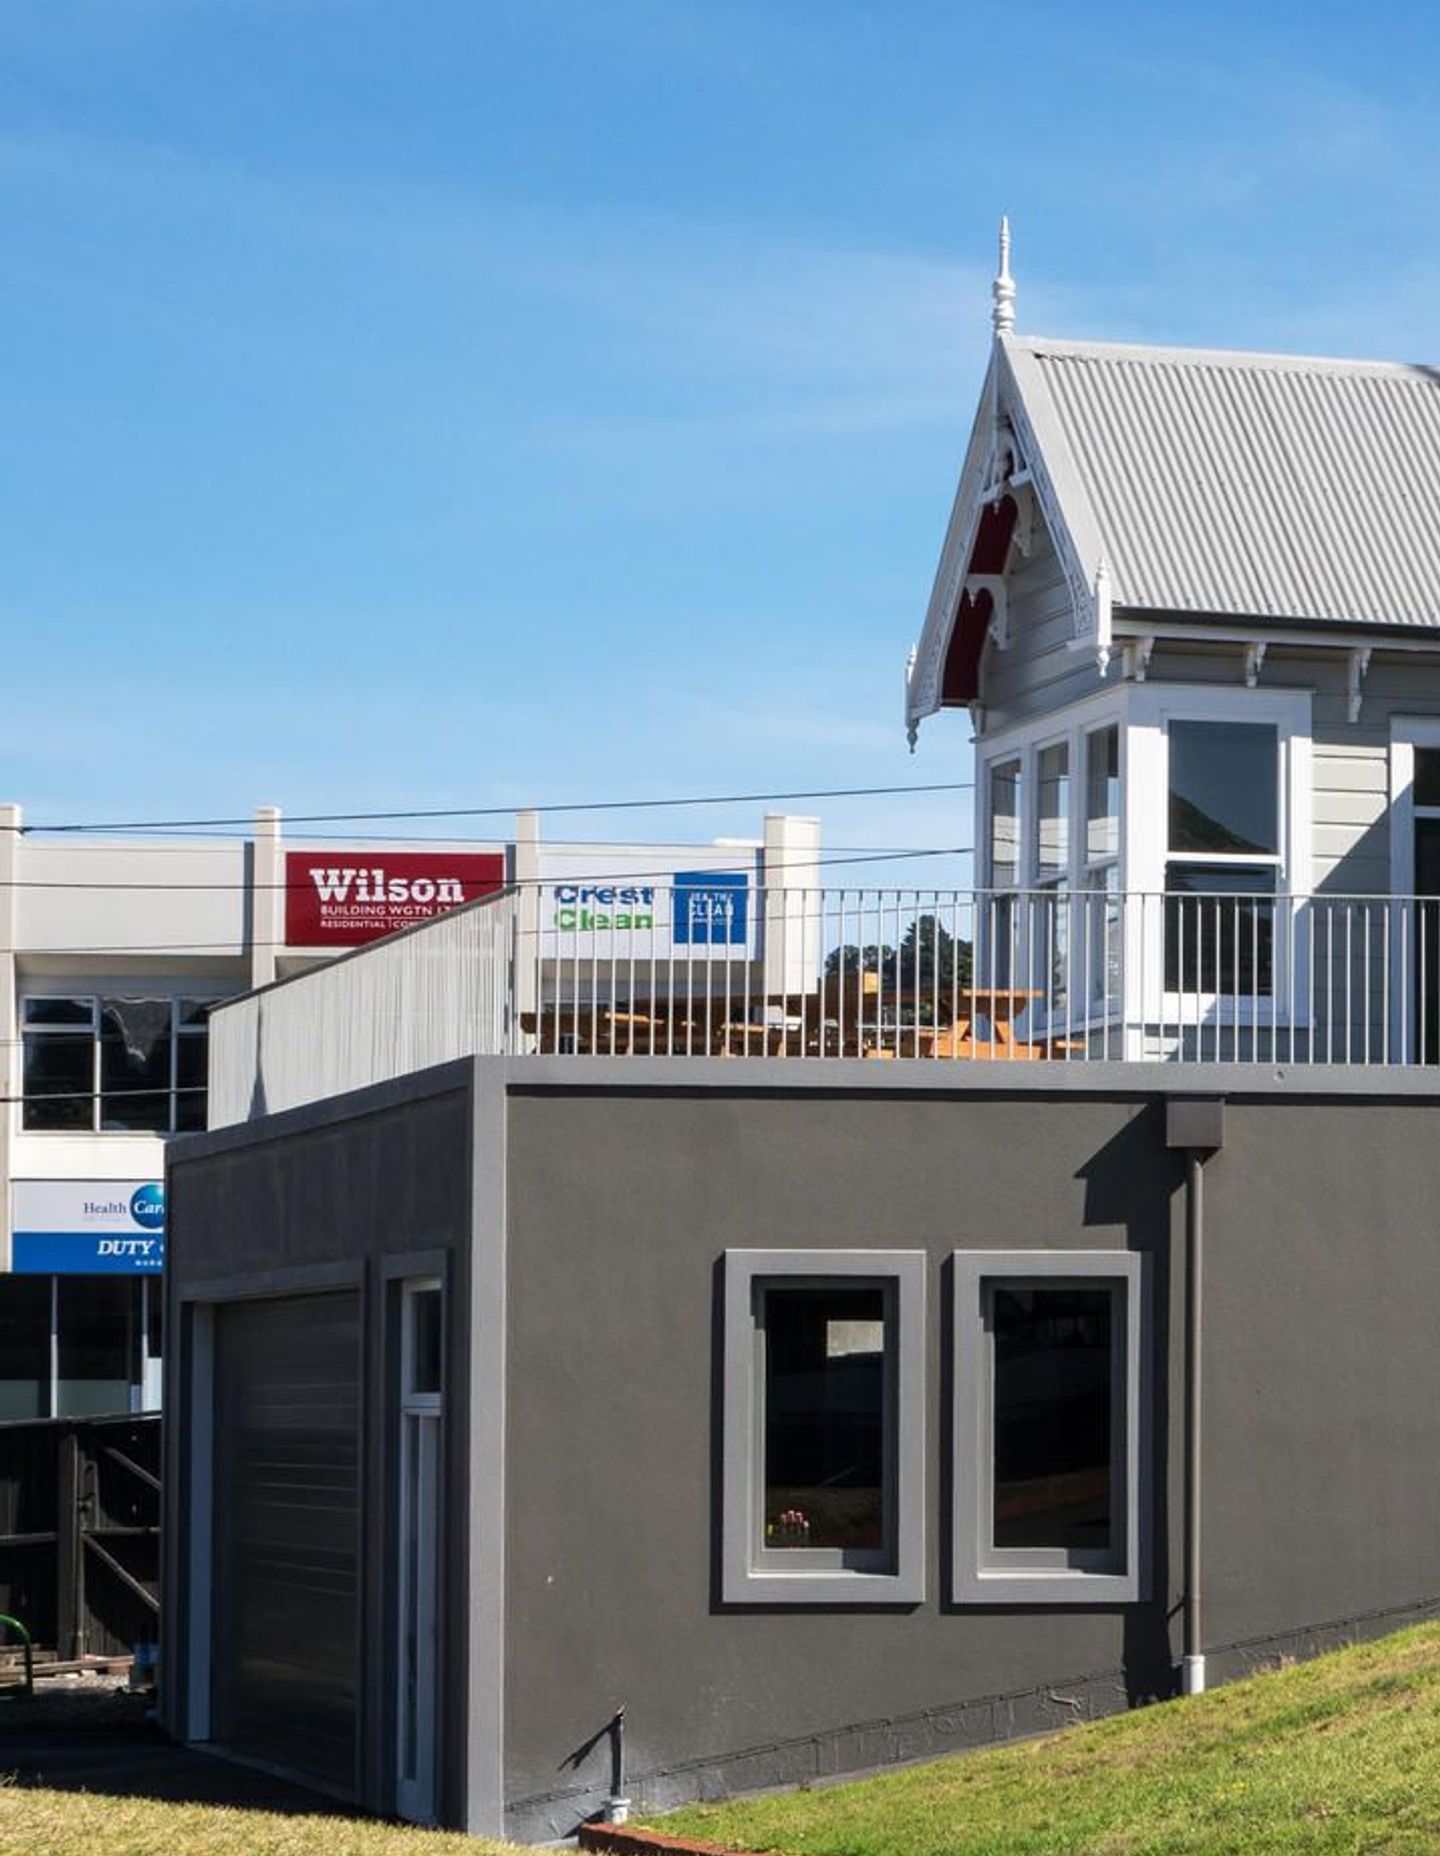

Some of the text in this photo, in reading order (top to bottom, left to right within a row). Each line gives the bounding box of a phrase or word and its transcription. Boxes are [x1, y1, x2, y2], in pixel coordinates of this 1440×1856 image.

[309, 868, 464, 902] Wilson
[554, 885, 654, 905] Crest
[320, 905, 386, 915] BUILDING
[389, 905, 432, 915] WGTN
[320, 920, 386, 928] RESIDENTIAL
[554, 908, 653, 930] Clean
[84, 1202, 127, 1214] Health
[97, 1240, 155, 1255] DUTY
